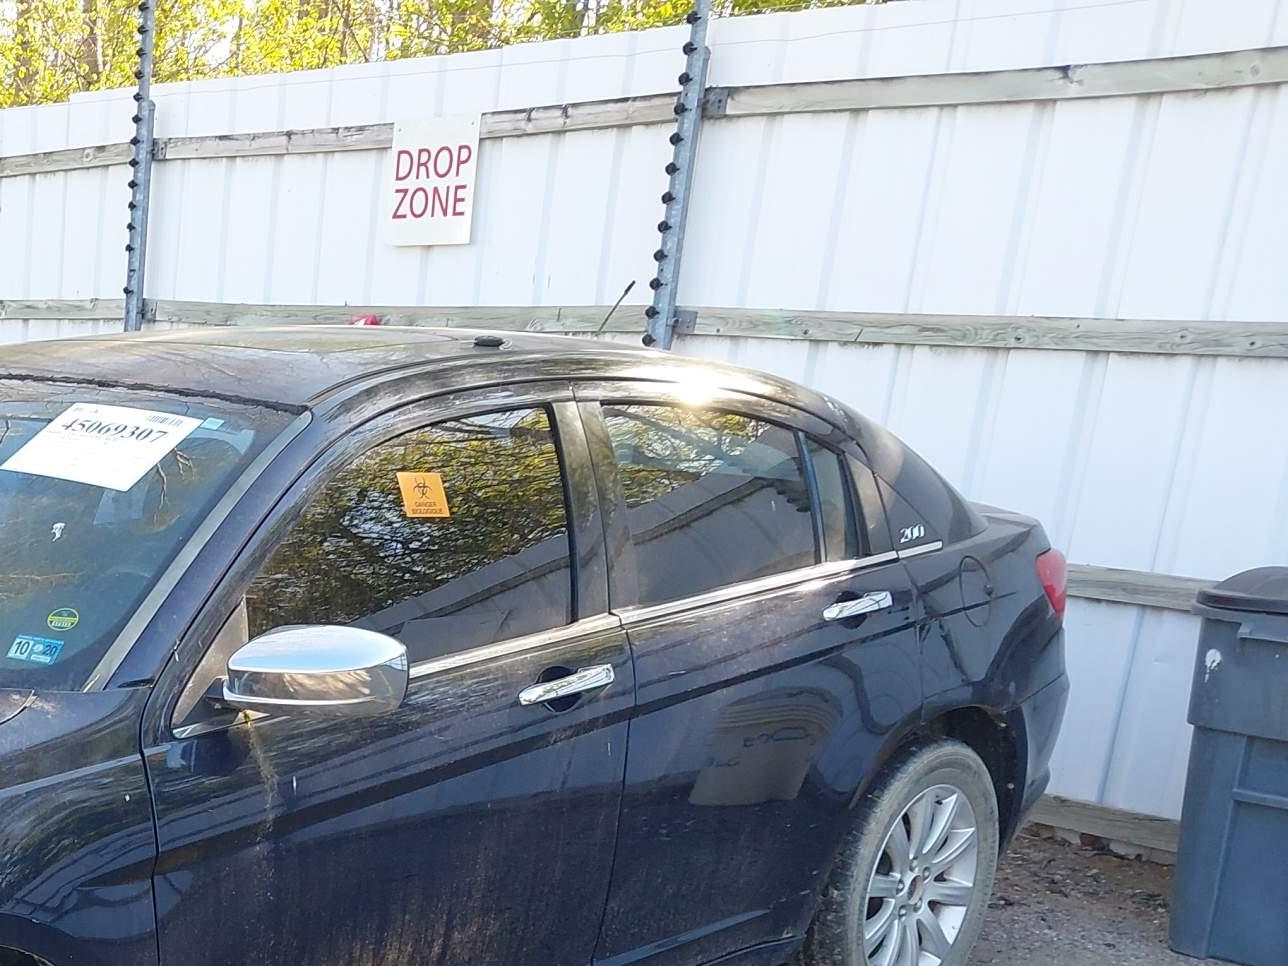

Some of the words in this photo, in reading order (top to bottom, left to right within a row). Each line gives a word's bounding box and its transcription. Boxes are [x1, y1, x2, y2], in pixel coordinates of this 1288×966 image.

[395, 144, 472, 181] DROP
[391, 184, 468, 219] ZONE
[61, 418, 169, 443] 45069307
[14, 640, 31, 656] 10
[41, 644, 59, 657] 20
